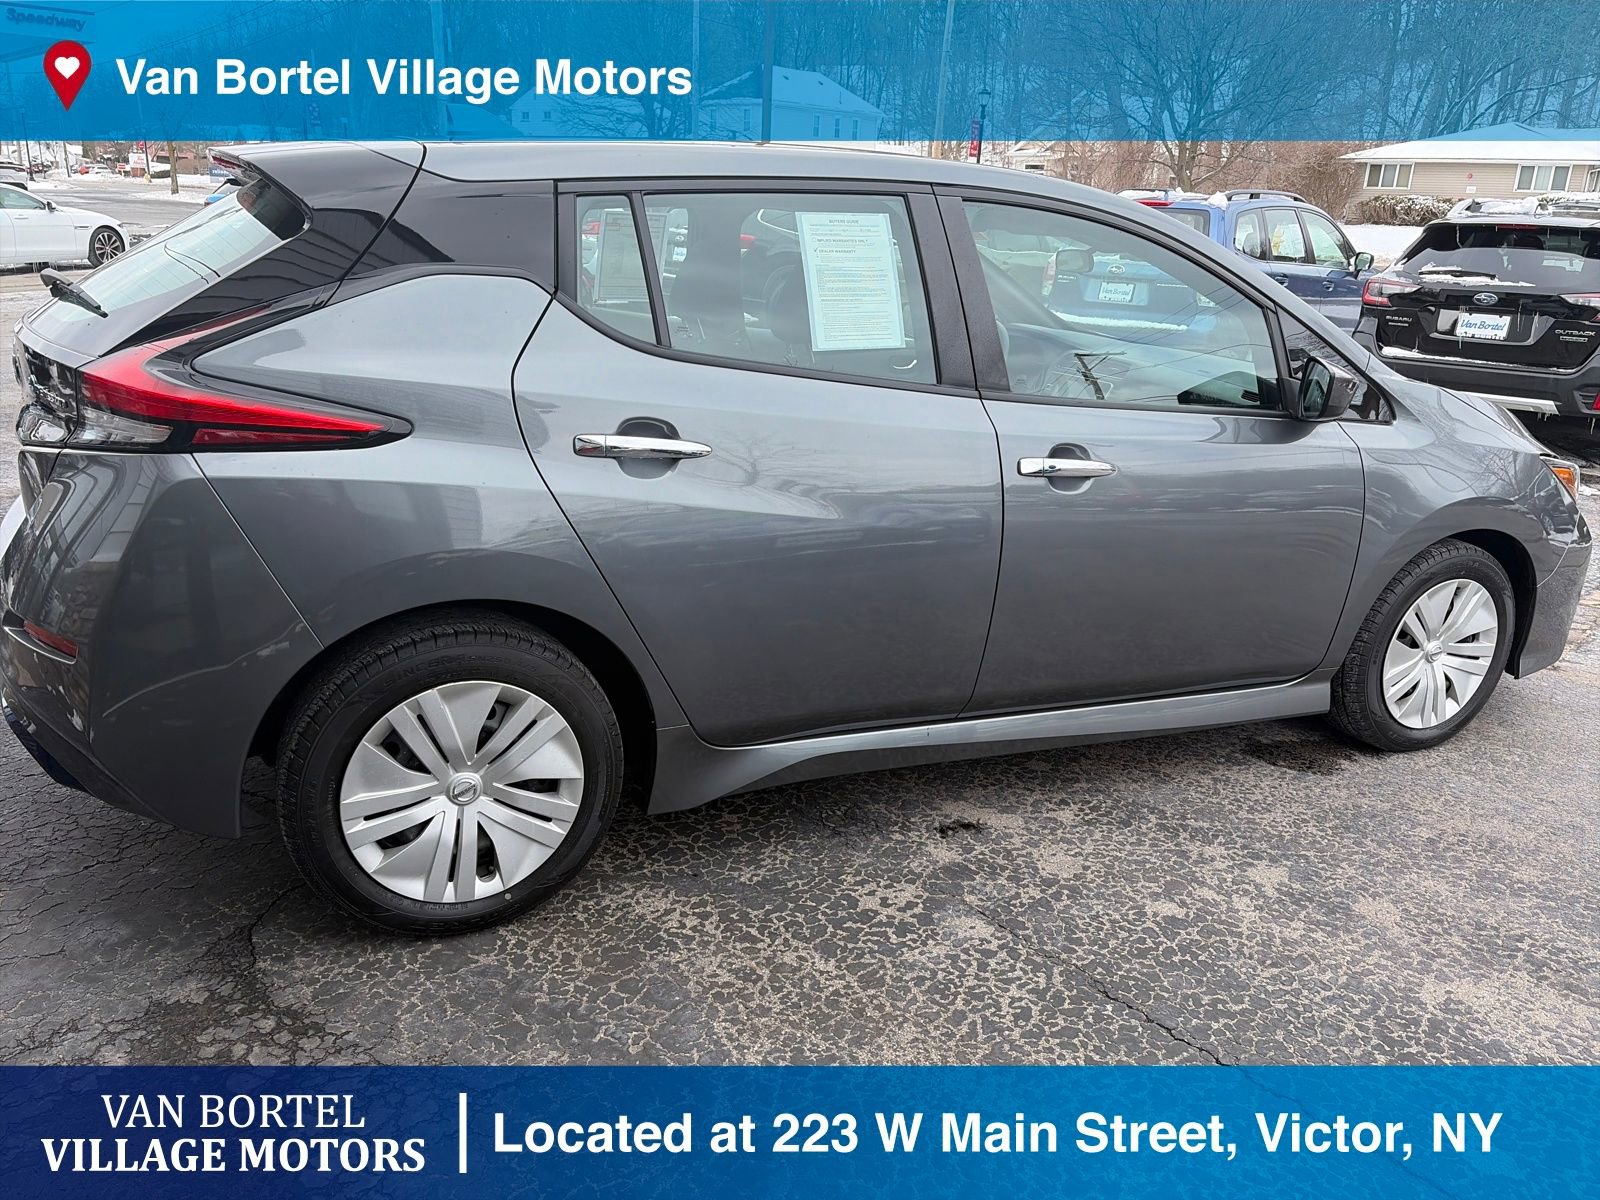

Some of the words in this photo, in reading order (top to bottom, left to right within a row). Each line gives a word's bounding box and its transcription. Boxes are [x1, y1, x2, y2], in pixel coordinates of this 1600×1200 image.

[6, 7, 86, 32] Speedway
[1460, 319, 1478, 329] Van
[1478, 320, 1507, 331] Bortel
[1554, 329, 1596, 337] OUTBACK
